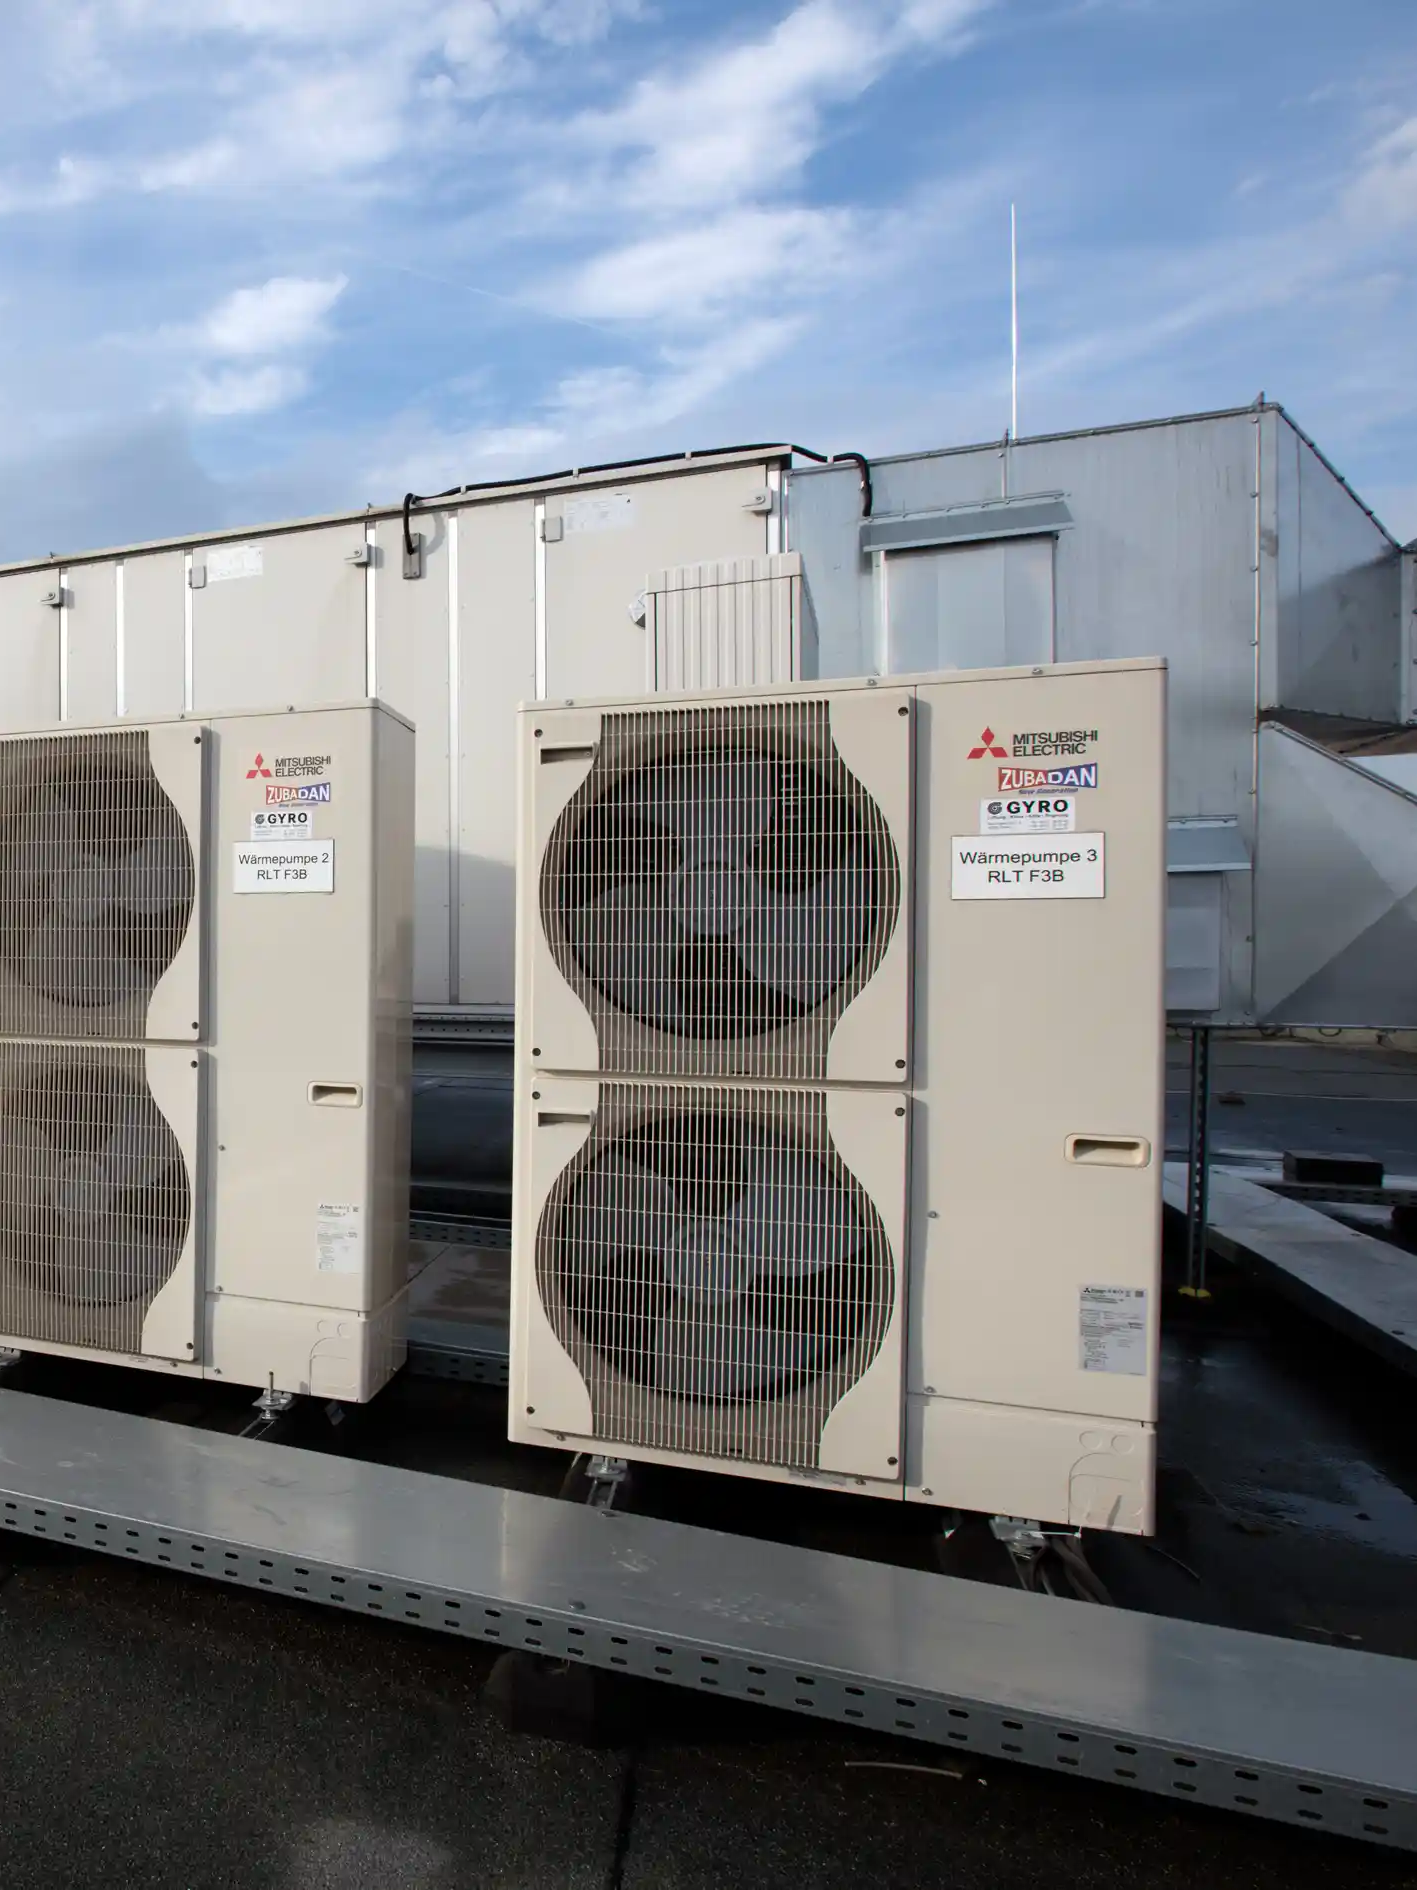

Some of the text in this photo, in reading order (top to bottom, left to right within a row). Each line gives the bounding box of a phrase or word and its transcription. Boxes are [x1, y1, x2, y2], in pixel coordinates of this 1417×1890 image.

[1012, 730, 1098, 745] MITSUBISHI
[1013, 743, 1087, 757] ELECTRIC
[275, 755, 331, 767] MITSUBISHI
[275, 766, 324, 777] ELECTRIC
[1000, 766, 1096, 790] ZUBADAN
[267, 784, 330, 803] ZUBADAN
[1006, 800, 1069, 814] GYRO
[267, 812, 308, 824] GYRO
[238, 852, 329, 866] Wärmepumpe 2
[959, 849, 1098, 865] Wärmepumpe 3
[257, 868, 308, 880] RLT F3B
[988, 869, 1064, 882] RLT F3B
